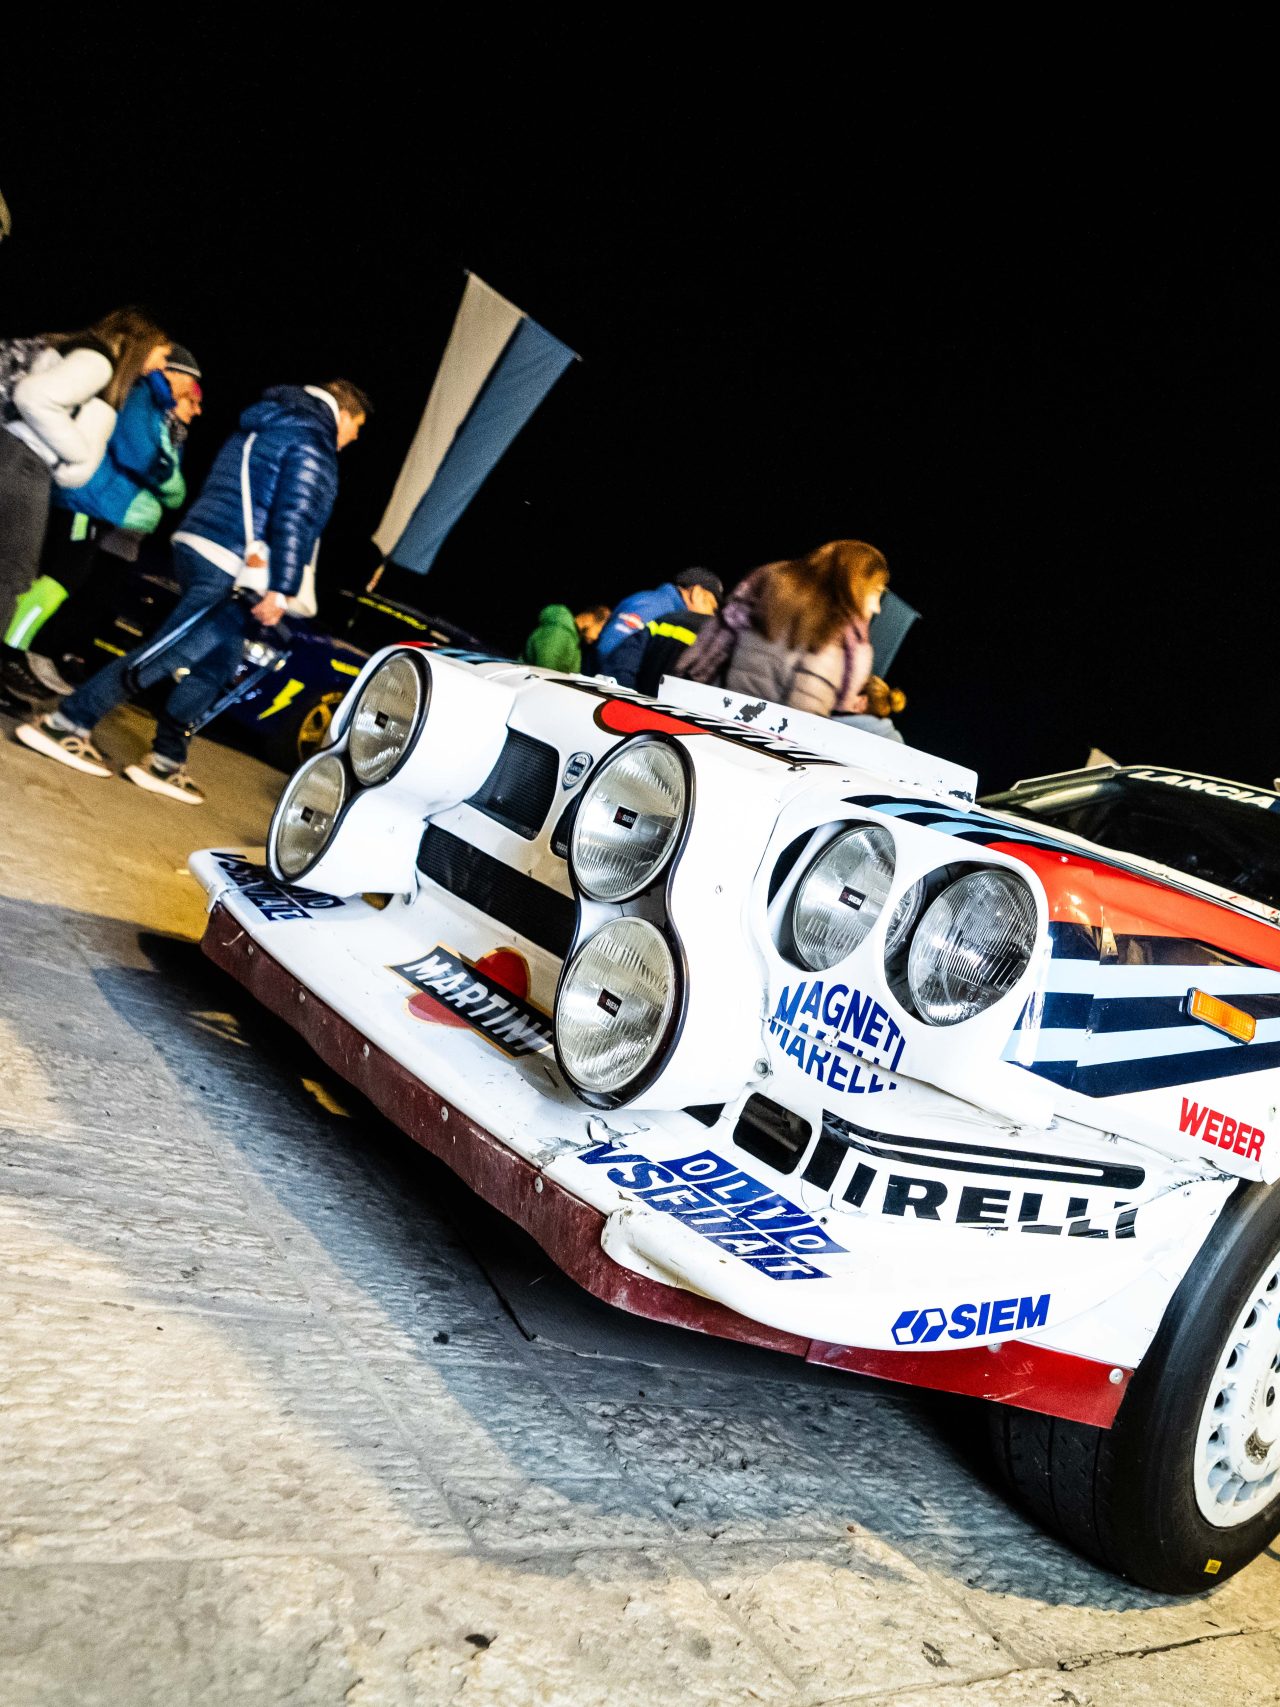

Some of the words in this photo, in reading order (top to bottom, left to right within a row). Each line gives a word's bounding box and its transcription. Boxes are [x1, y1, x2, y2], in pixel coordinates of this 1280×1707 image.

[1128, 770, 1276, 809] LANCIA
[403, 954, 553, 1051] MARTINI
[775, 980, 906, 1066] MAGNETI
[1179, 1097, 1265, 1162] WEBER
[800, 1109, 1145, 1239] PIRELLI
[947, 1294, 1051, 1339] SIEM
